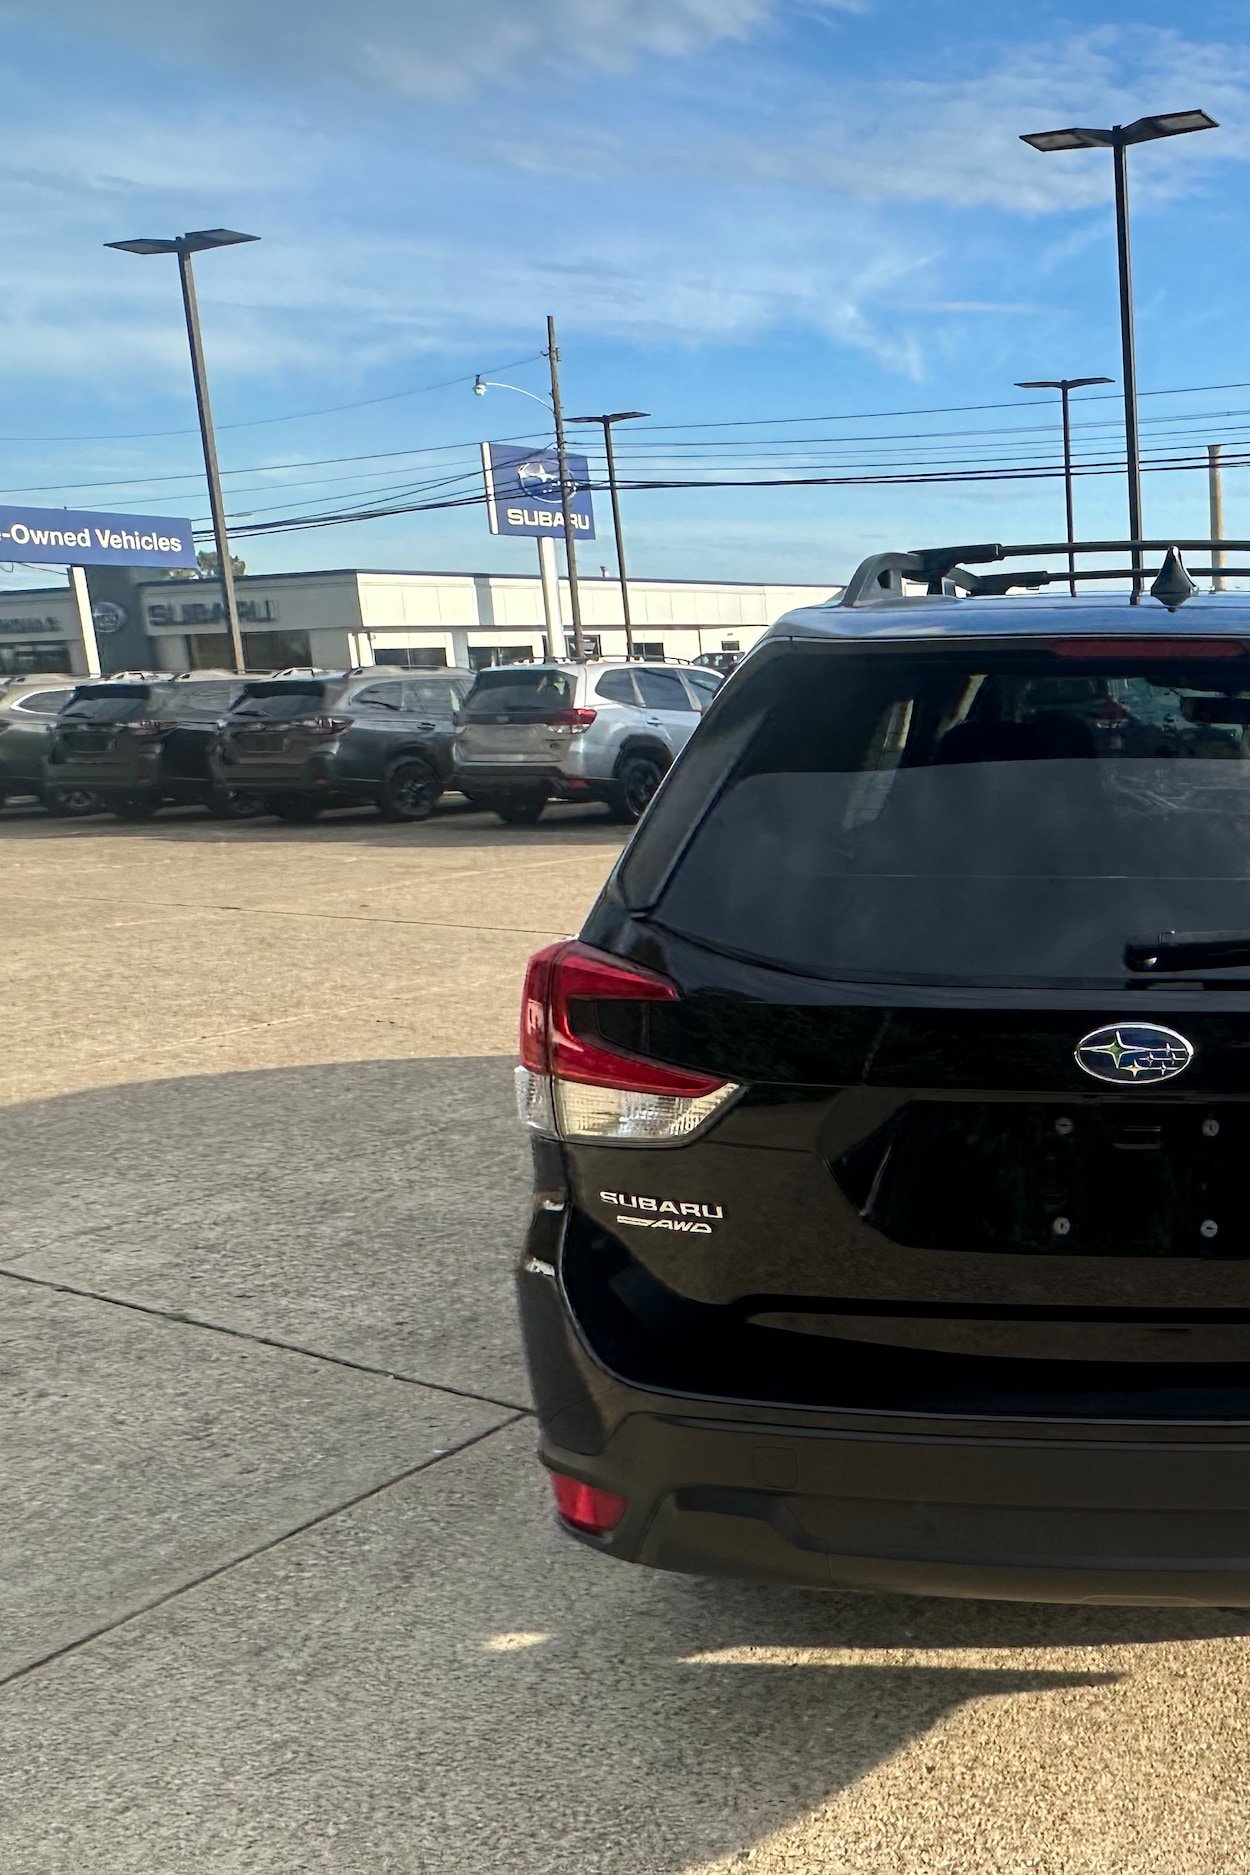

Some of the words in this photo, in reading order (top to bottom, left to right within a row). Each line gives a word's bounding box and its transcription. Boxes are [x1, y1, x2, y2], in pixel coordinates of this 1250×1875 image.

[507, 508, 590, 530] SUBARU
[0, 524, 91, 548] -Owned
[95, 529, 182, 552] Vehicles
[600, 1191, 723, 1219] SUBARU
